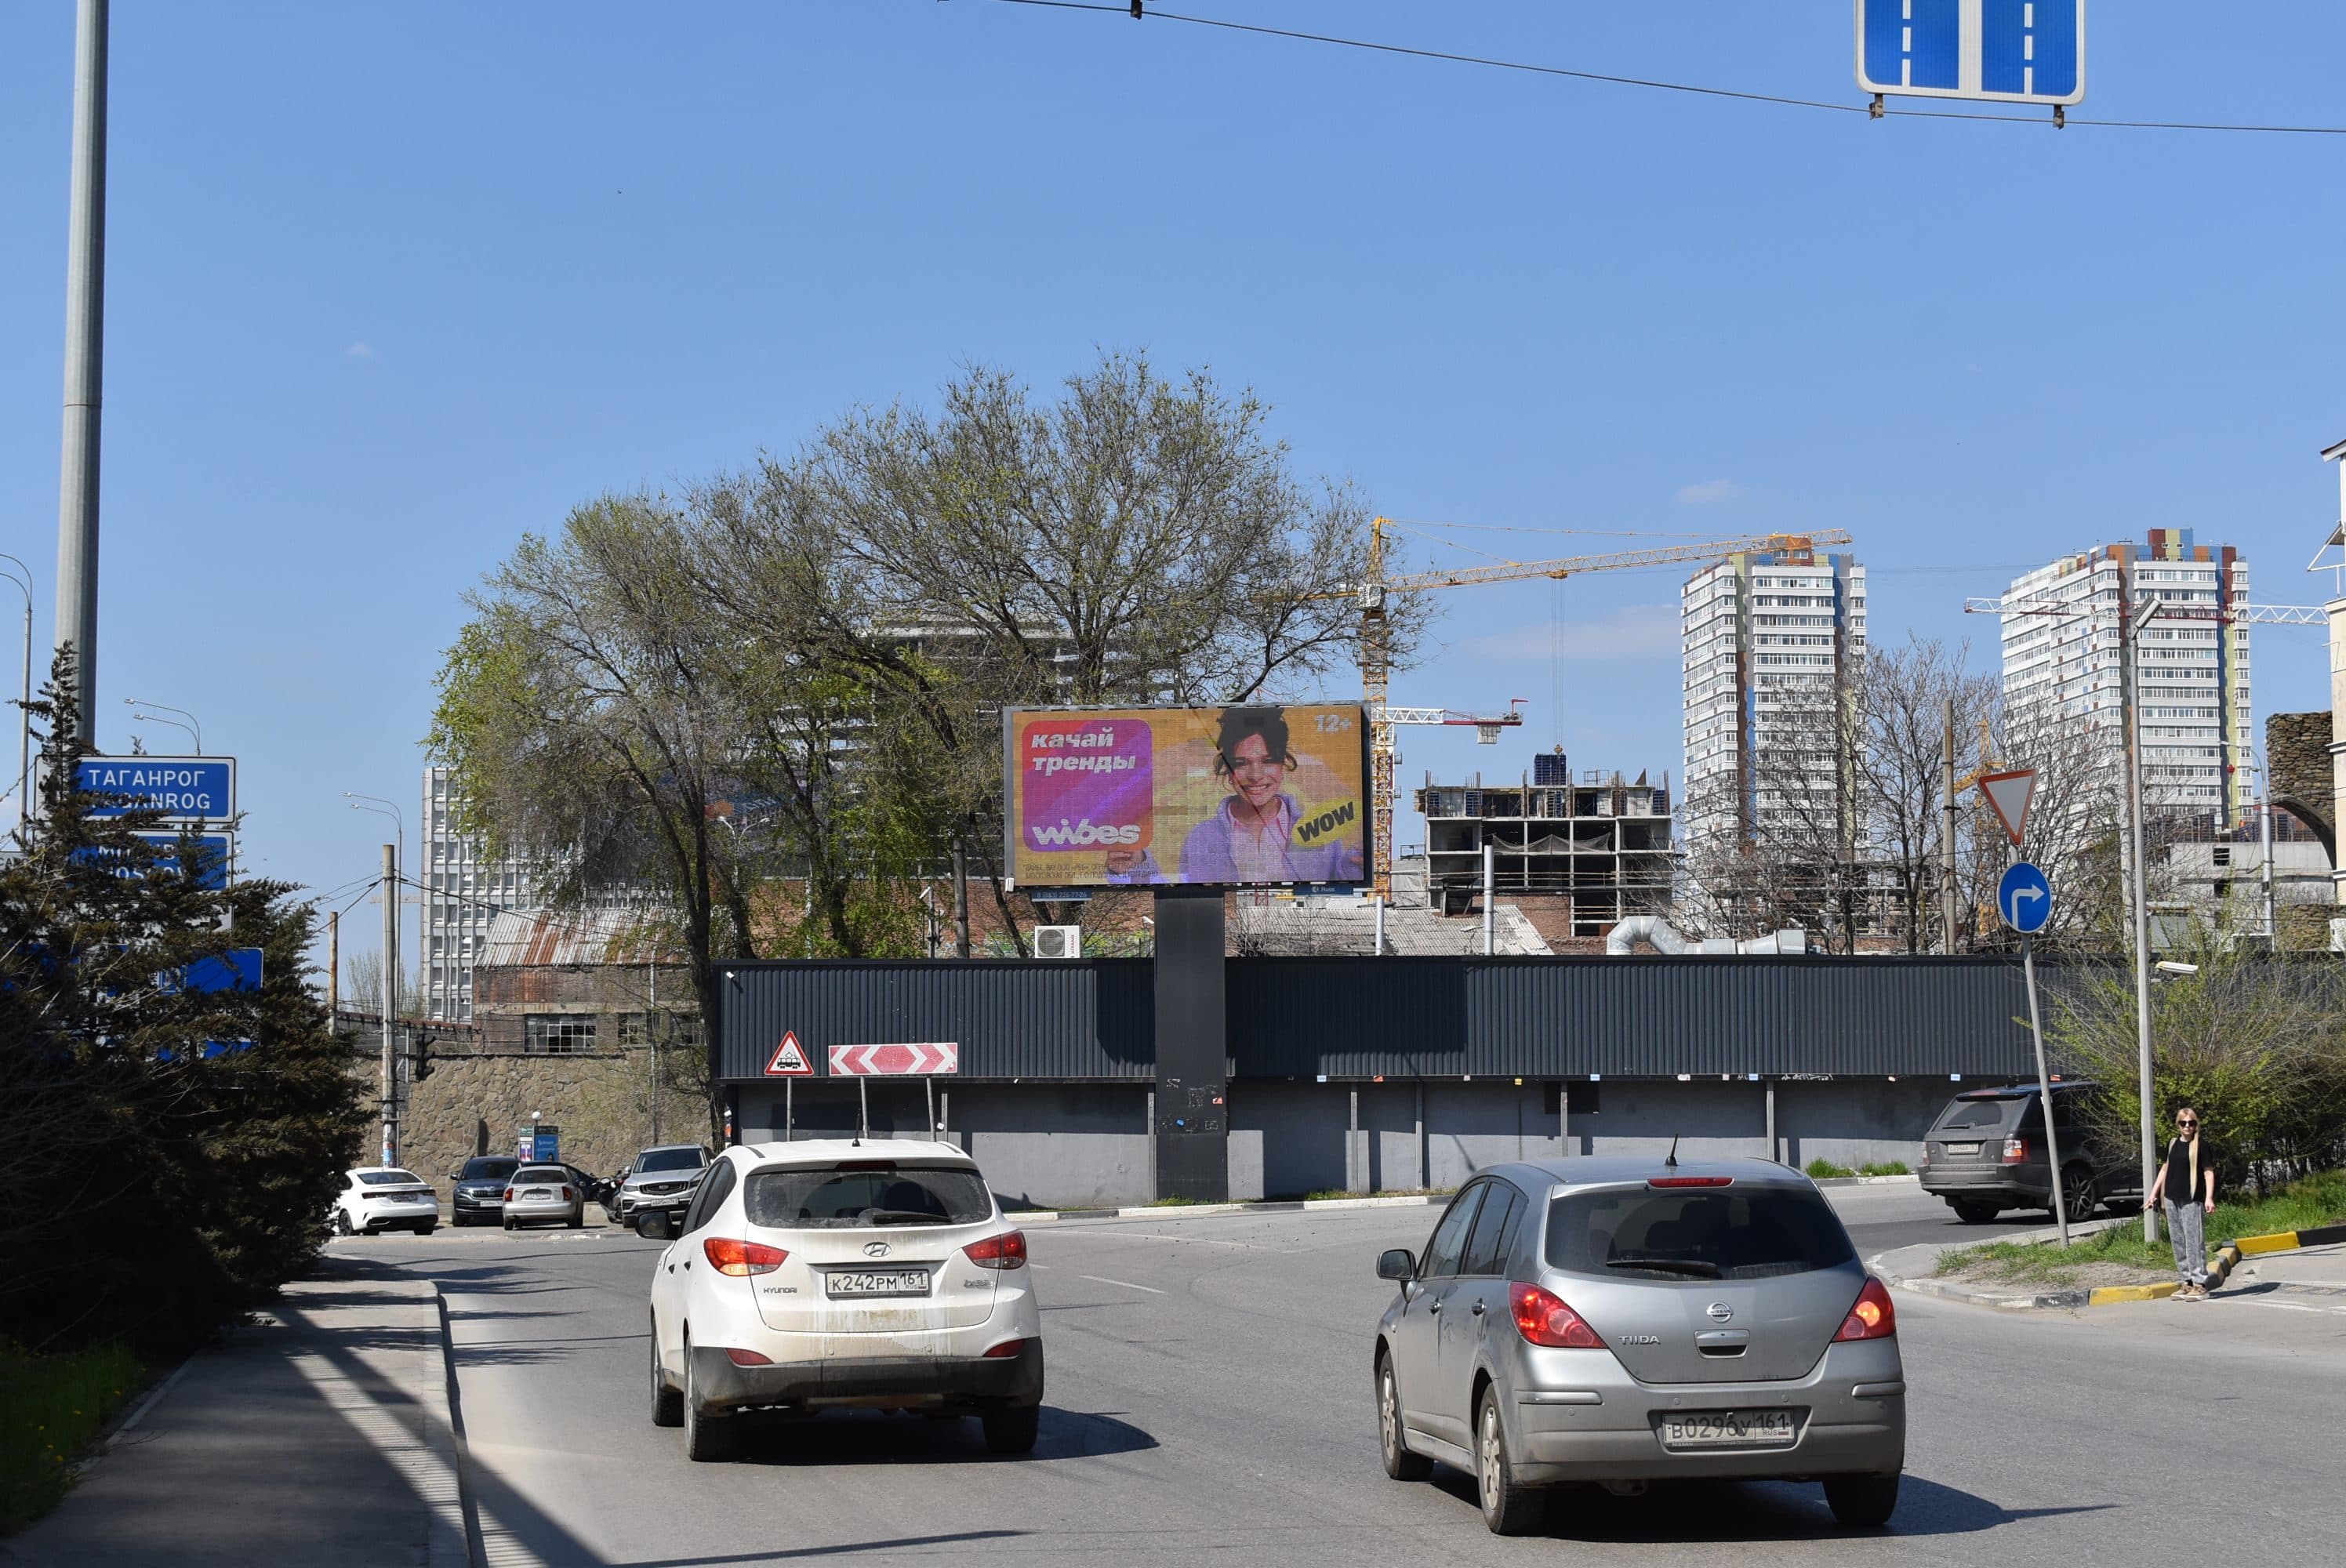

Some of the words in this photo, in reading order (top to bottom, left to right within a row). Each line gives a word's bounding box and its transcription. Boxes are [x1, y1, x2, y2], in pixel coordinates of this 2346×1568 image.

[1313, 714, 1352, 733] 12+
[1031, 727, 1114, 748] качай
[1032, 755, 1136, 777] тренды
[88, 769, 206, 787] ТАГАНРОГ
[89, 791, 210, 810] GANROG
[1031, 818, 1141, 845] wibes
[832, 1274, 898, 1291] К242РМ
[900, 1272, 924, 1286] 161
[1618, 1335, 1660, 1345] TIIDA
[1756, 1412, 1786, 1430] 161
